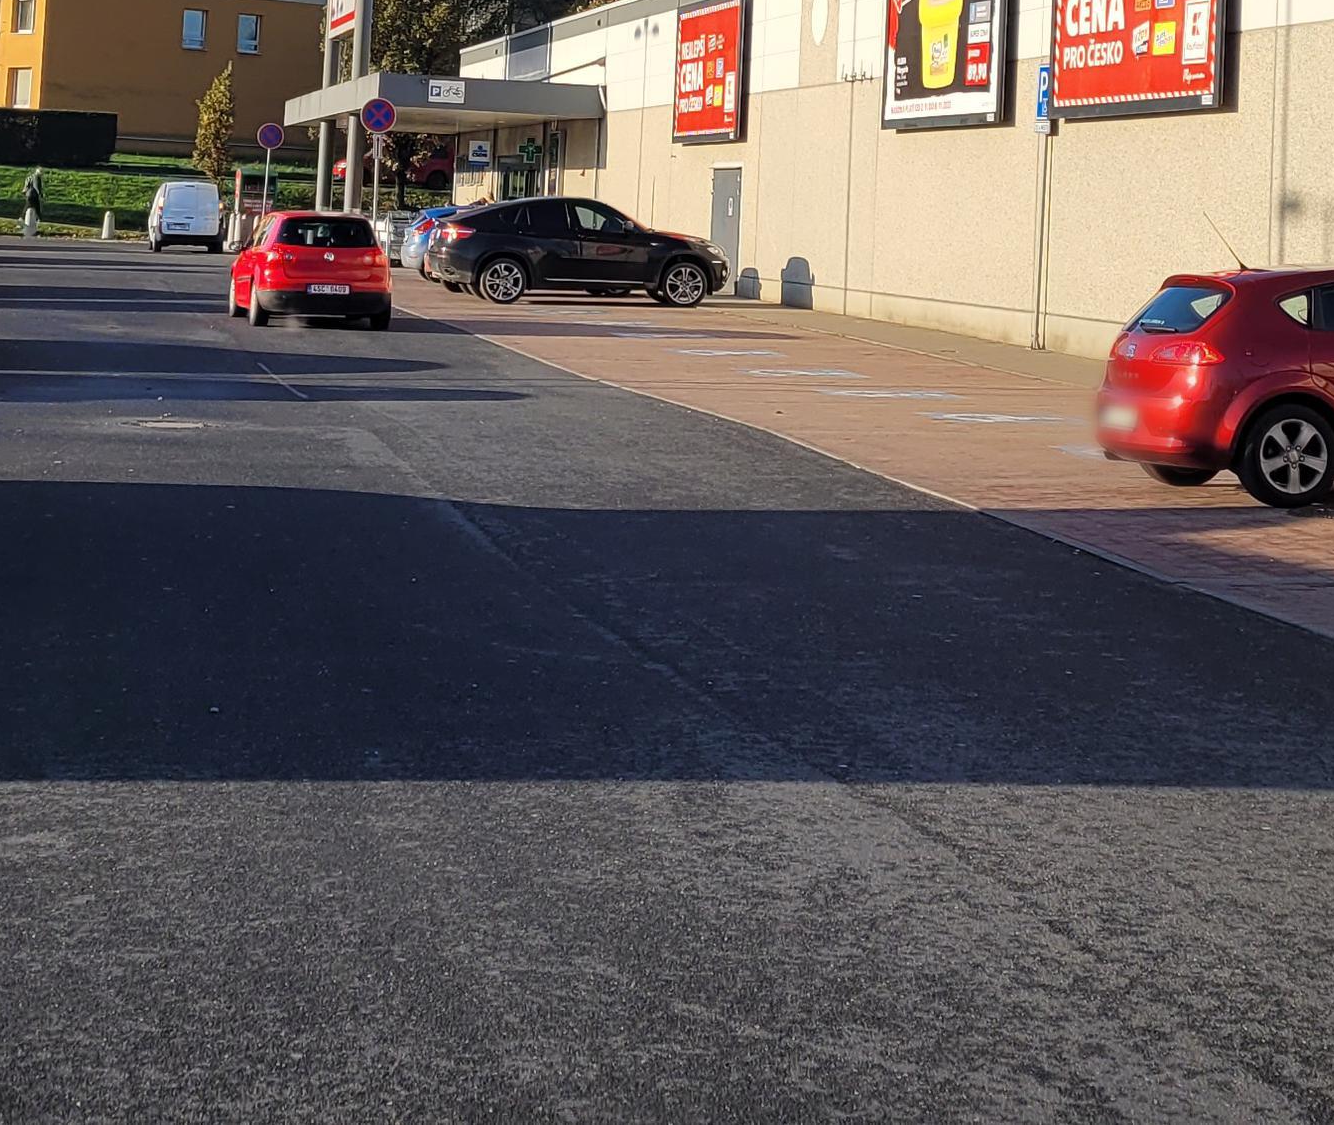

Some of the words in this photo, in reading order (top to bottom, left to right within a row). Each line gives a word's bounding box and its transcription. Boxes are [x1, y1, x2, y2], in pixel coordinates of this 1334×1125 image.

[1063, 45, 1086, 71] PRO
[1087, 38, 1123, 68] ČESKO
[1039, 71, 1049, 103] P
